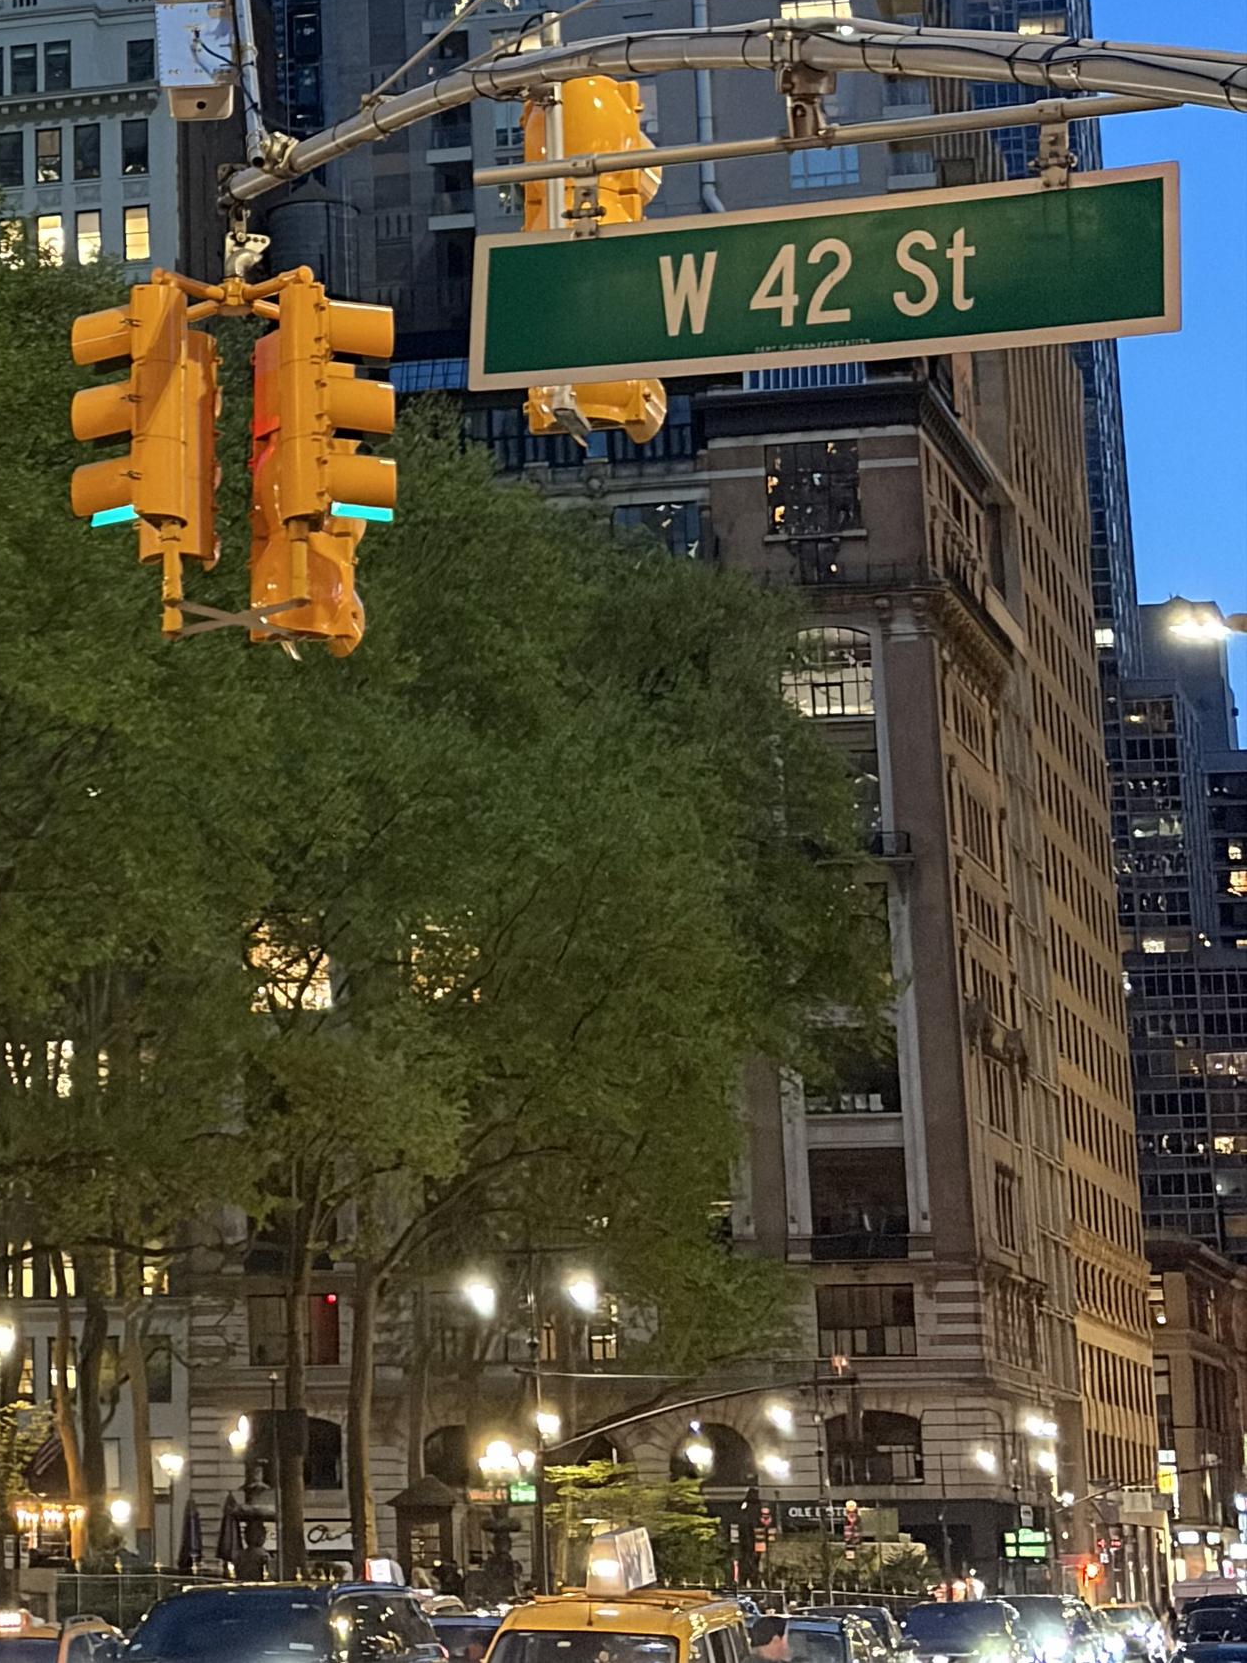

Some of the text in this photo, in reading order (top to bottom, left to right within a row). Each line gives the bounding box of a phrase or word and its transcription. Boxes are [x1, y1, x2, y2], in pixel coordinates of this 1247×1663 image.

[659, 227, 975, 337] W 42 St
